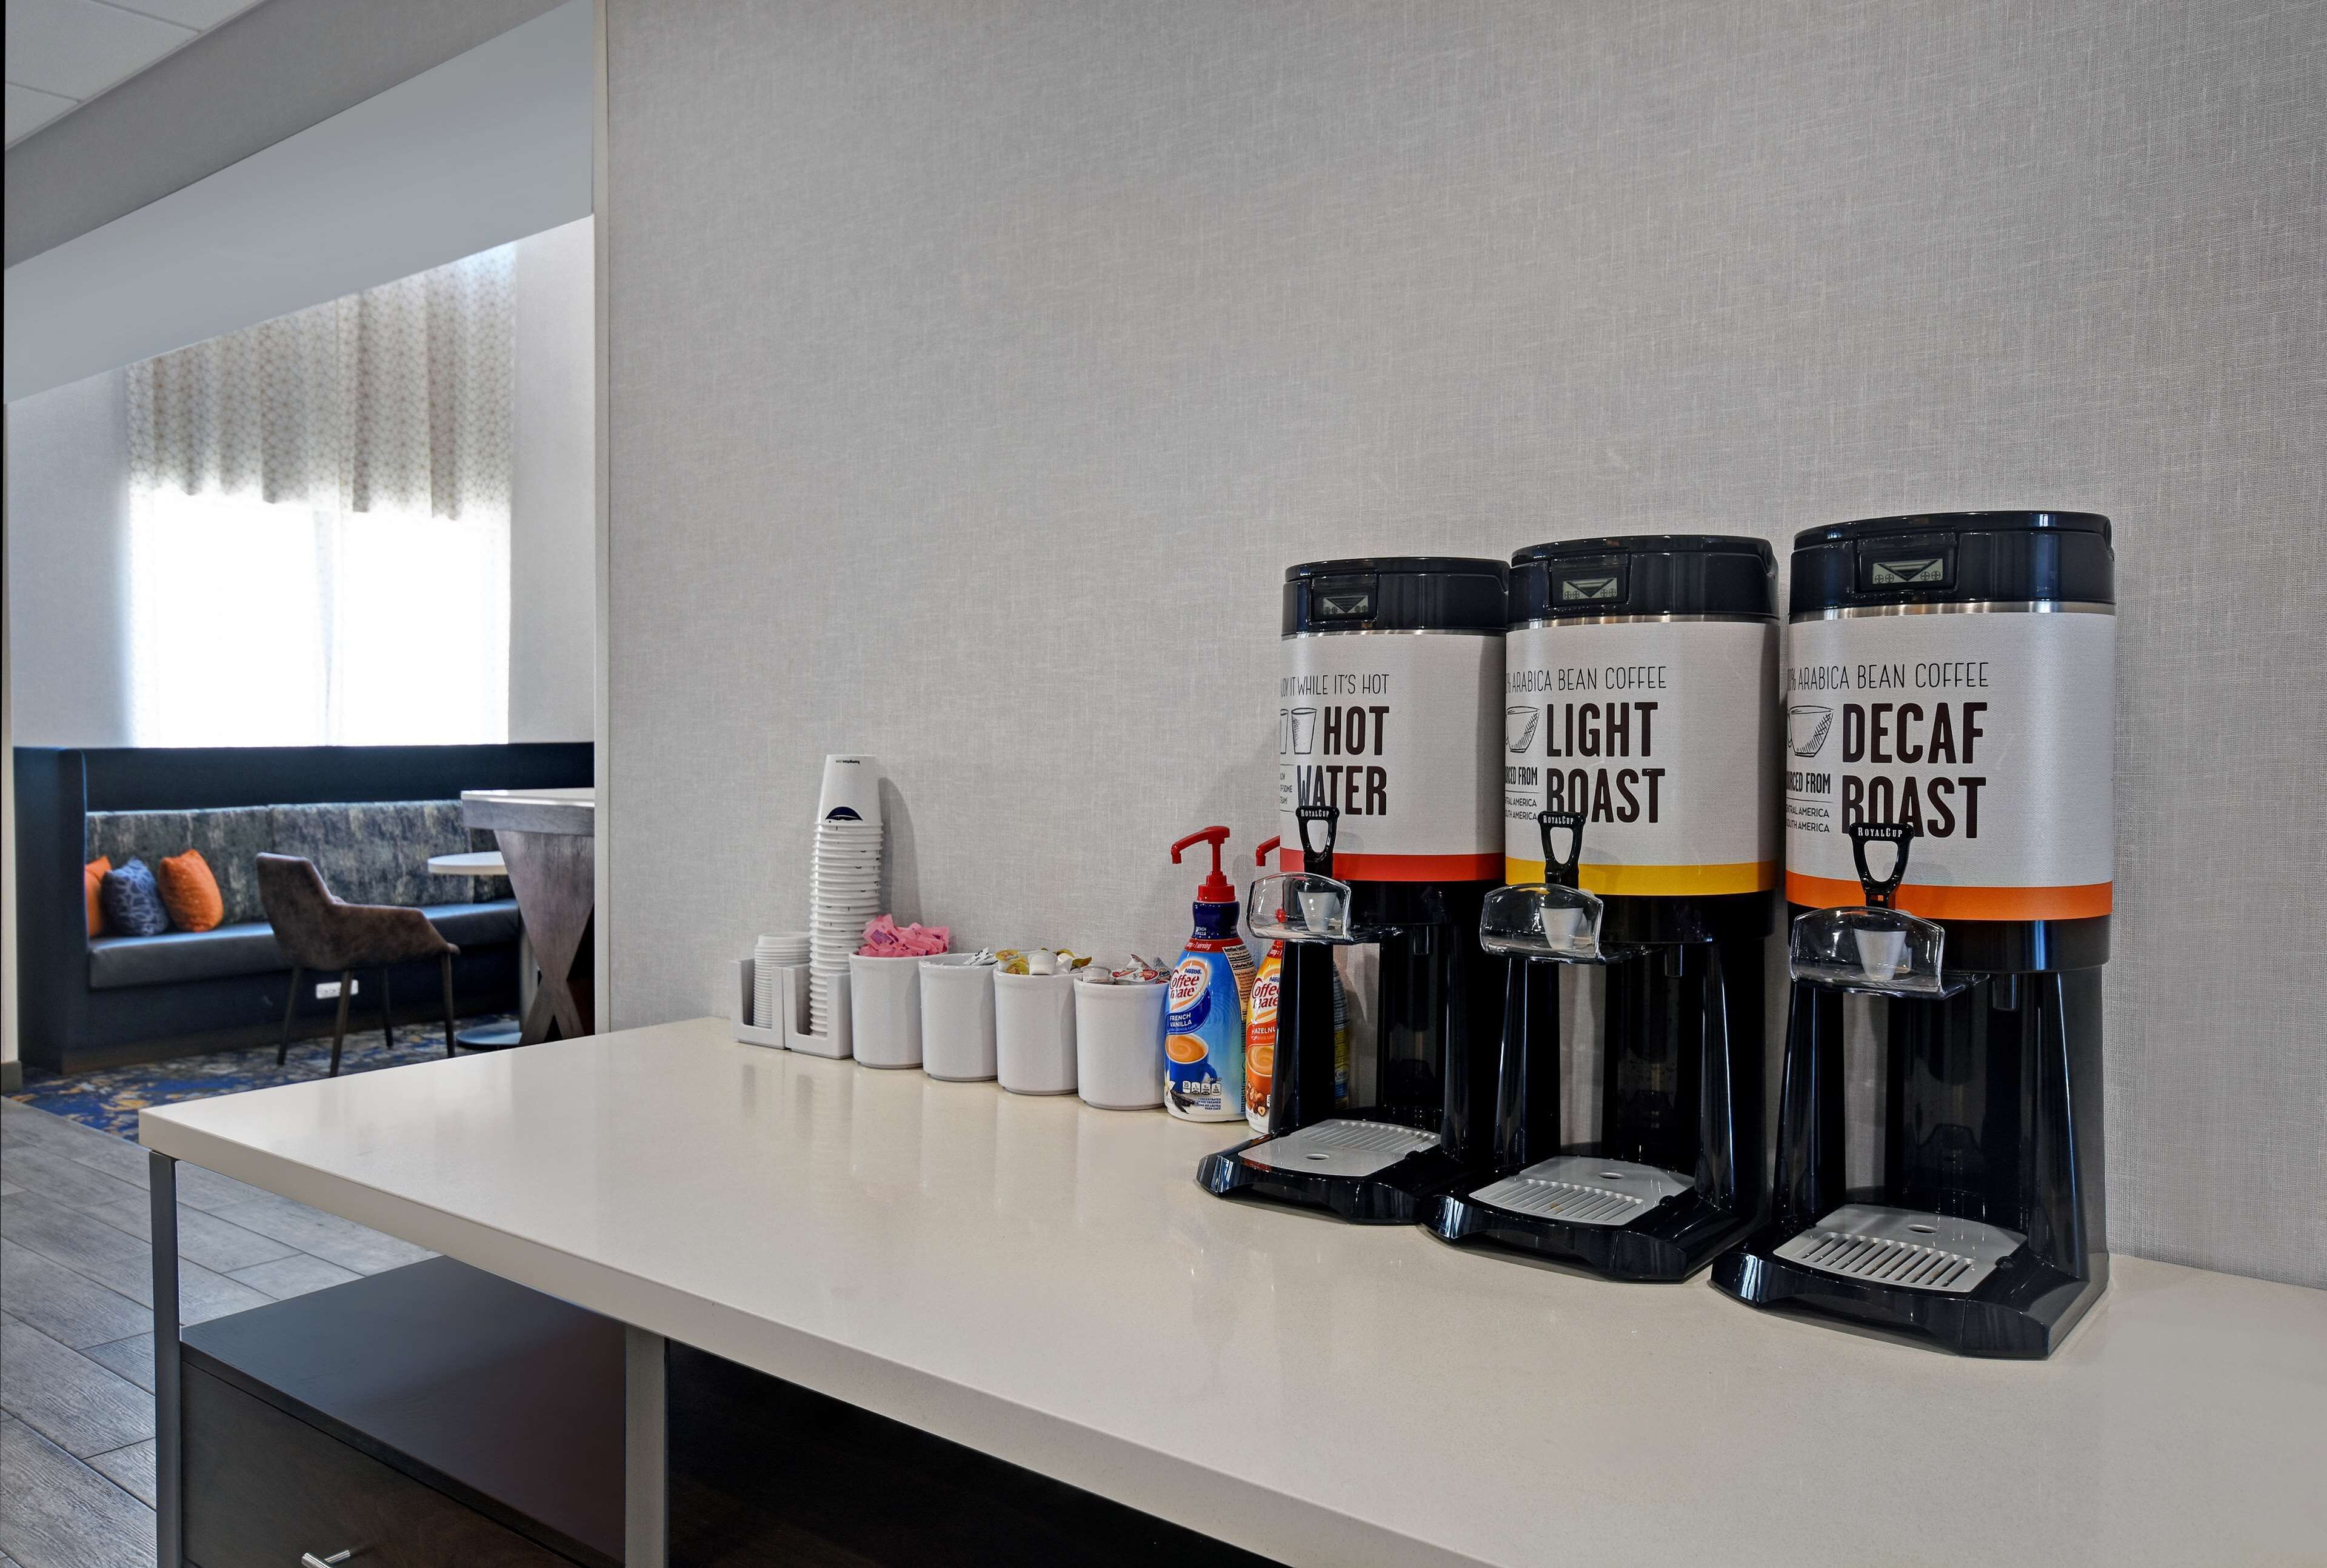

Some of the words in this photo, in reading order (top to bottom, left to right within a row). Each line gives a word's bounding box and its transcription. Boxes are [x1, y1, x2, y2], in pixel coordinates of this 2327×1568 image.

[1290, 676, 1296, 696] IT
[1297, 675, 1328, 695] WHILE
[1334, 674, 1356, 695] IT'S
[1363, 674, 1390, 694] HOT
[1512, 670, 1552, 692] ARABICA
[1558, 668, 1597, 690] BEAN
[1606, 666, 1667, 689] COFFEE
[1798, 666, 1849, 690] ARABICA
[1858, 664, 1905, 689] BEAN
[1915, 662, 1989, 688] COFFEE
[1324, 706, 1390, 755] HOT
[1547, 702, 1658, 757] LIGHT
[1842, 702, 1988, 764] DECAF
[1518, 767, 1538, 786] FROM
[1806, 772, 1831, 794] FROM
[1297, 766, 1387, 815] WATER
[1547, 768, 1666, 823] ROAST
[1513, 798, 1537, 807] AMERICA
[1798, 807, 1829, 818] AMERICA
[1842, 775, 1987, 839] ROAST
[1513, 812, 1537, 820] AMERICA
[1798, 821, 1830, 833] AMERICA
[1170, 969, 1200, 989] Coffee
[1169, 1012, 1191, 1021] FRENCH
